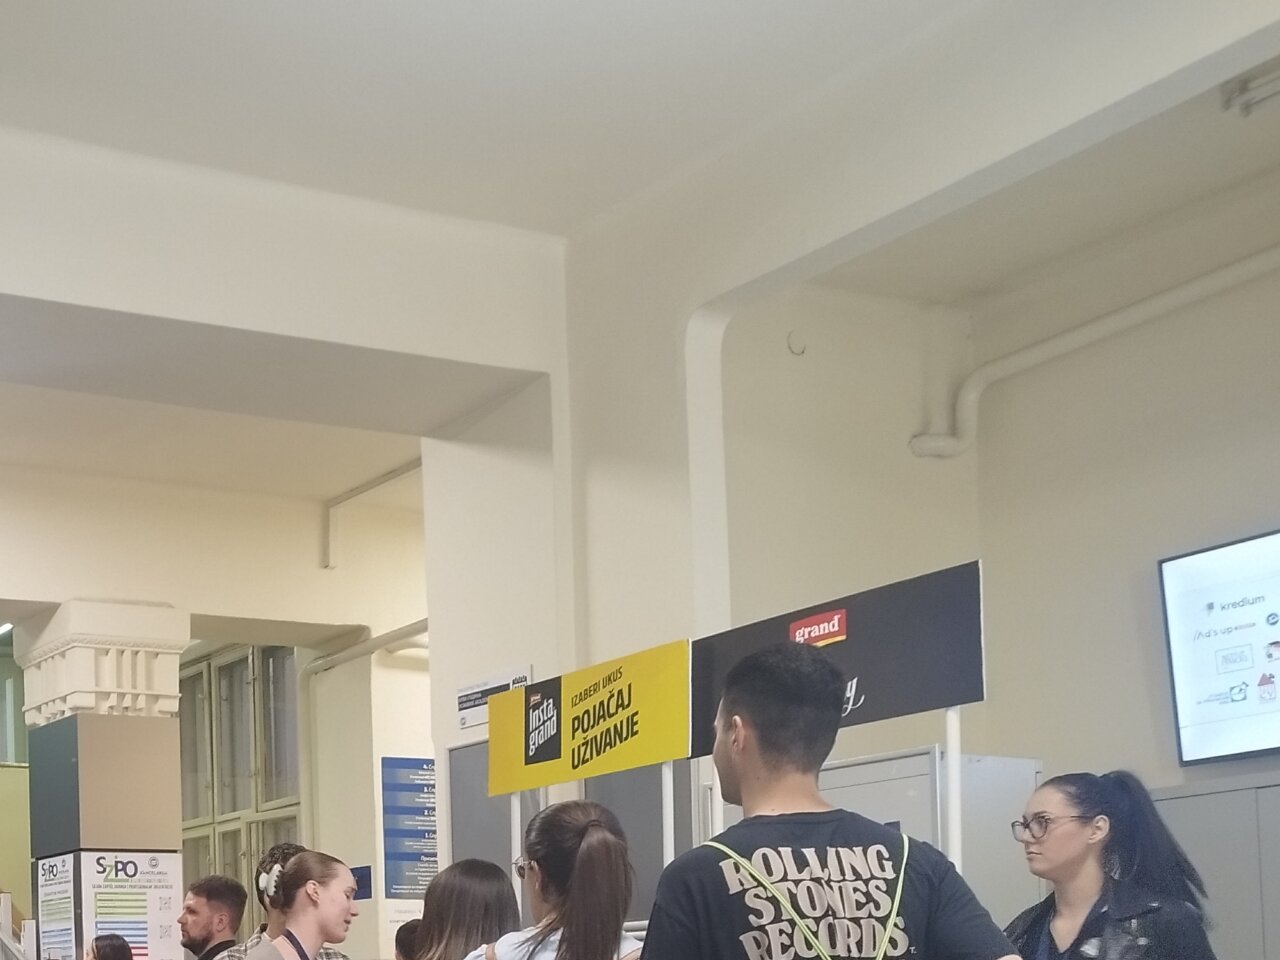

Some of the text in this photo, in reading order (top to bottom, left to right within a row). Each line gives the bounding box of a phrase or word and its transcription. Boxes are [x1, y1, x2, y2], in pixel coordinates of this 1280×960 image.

[795, 614, 841, 644] grand
[572, 666, 623, 709] IZABERI UKUS
[529, 697, 554, 733] Insta
[529, 709, 557, 756] grand
[571, 683, 632, 741] POJAČAJ
[571, 711, 639, 770] UŽIVANJE
[719, 845, 896, 895] ROLLING
[744, 879, 892, 927] STONES
